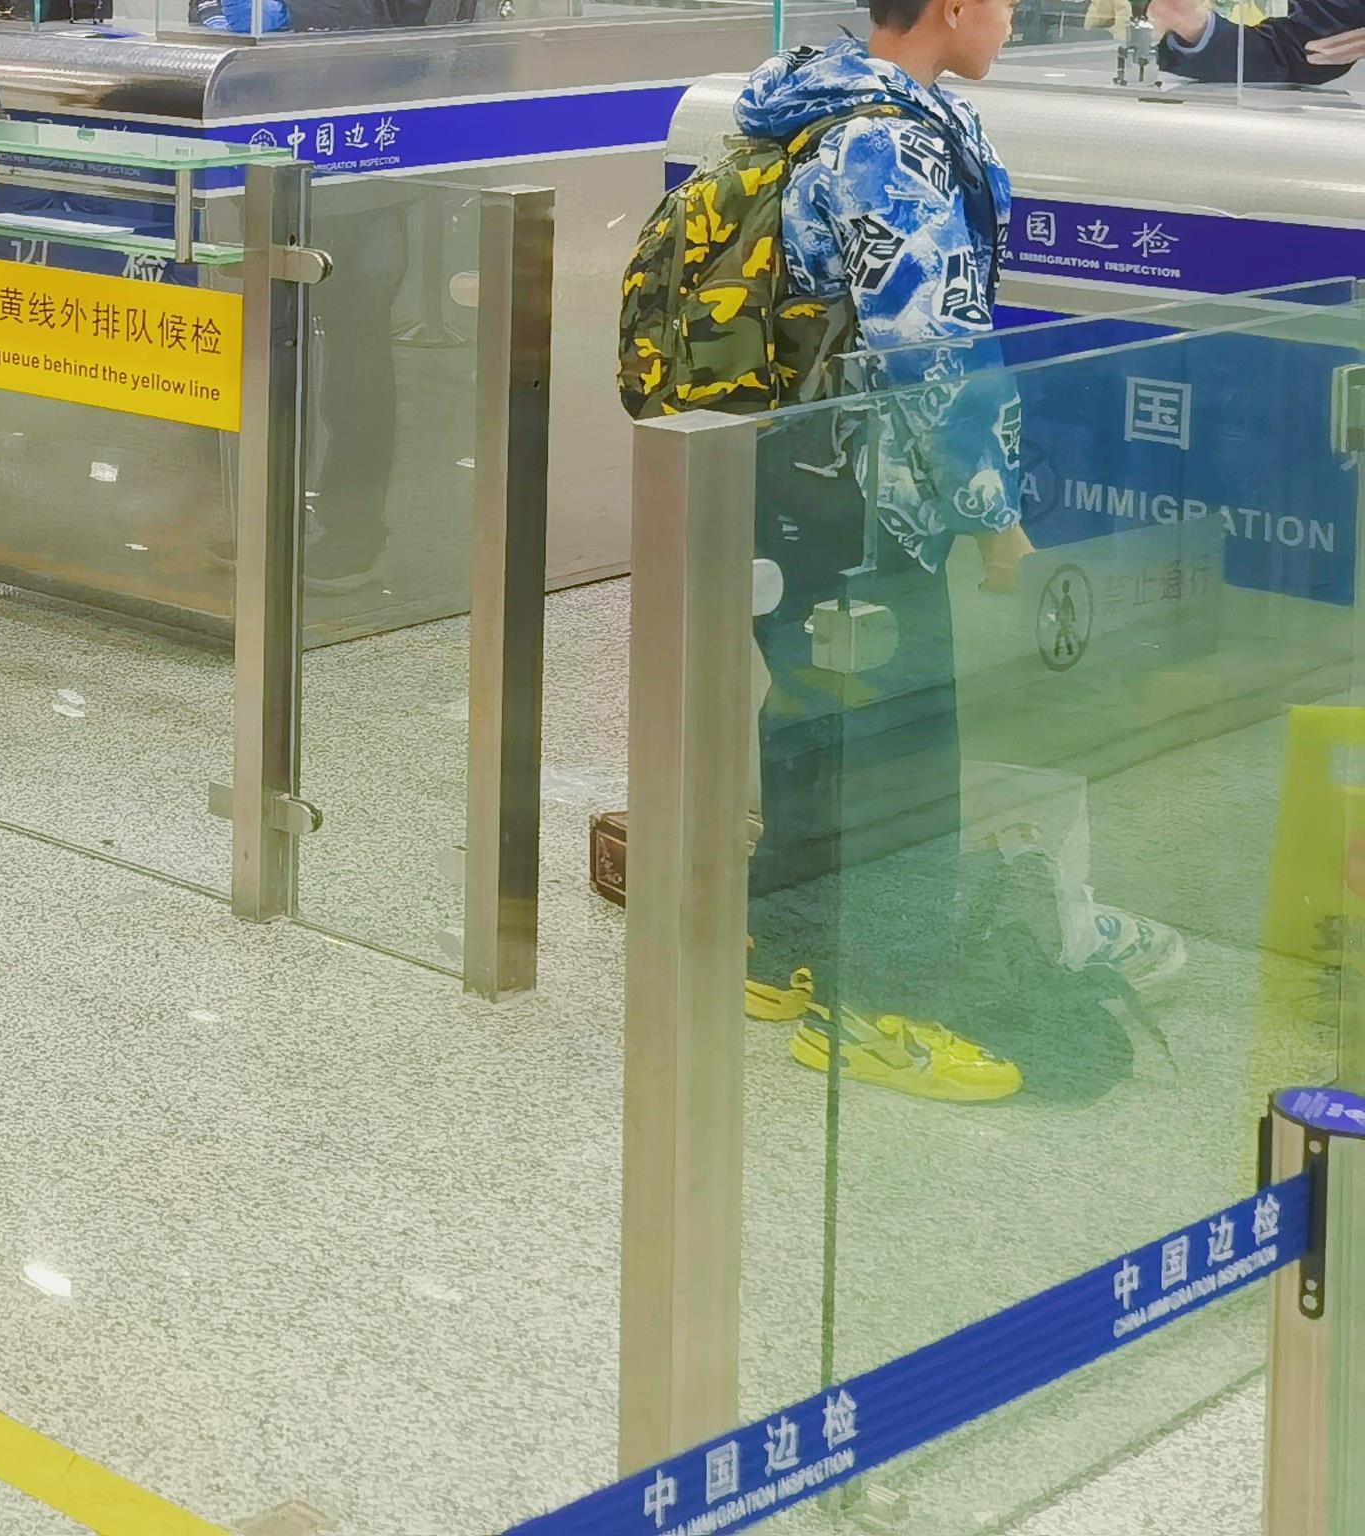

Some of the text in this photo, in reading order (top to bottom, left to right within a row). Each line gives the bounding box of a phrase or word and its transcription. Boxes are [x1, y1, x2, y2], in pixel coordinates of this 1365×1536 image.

[287, 116, 401, 157] 中国边检
[1019, 250, 1100, 270] IMMIGRATION
[1104, 260, 1181, 278] INSPECTION
[44, 353, 98, 379] behind
[102, 366, 127, 384] the
[131, 373, 186, 395] yellow
[189, 380, 220, 401] line
[1124, 376, 1192, 451] 国
[1113, 1193, 1281, 1310] 中国边检
[644, 1388, 861, 1529] 中国边检
[777, 1447, 855, 1501] INSPECTION
